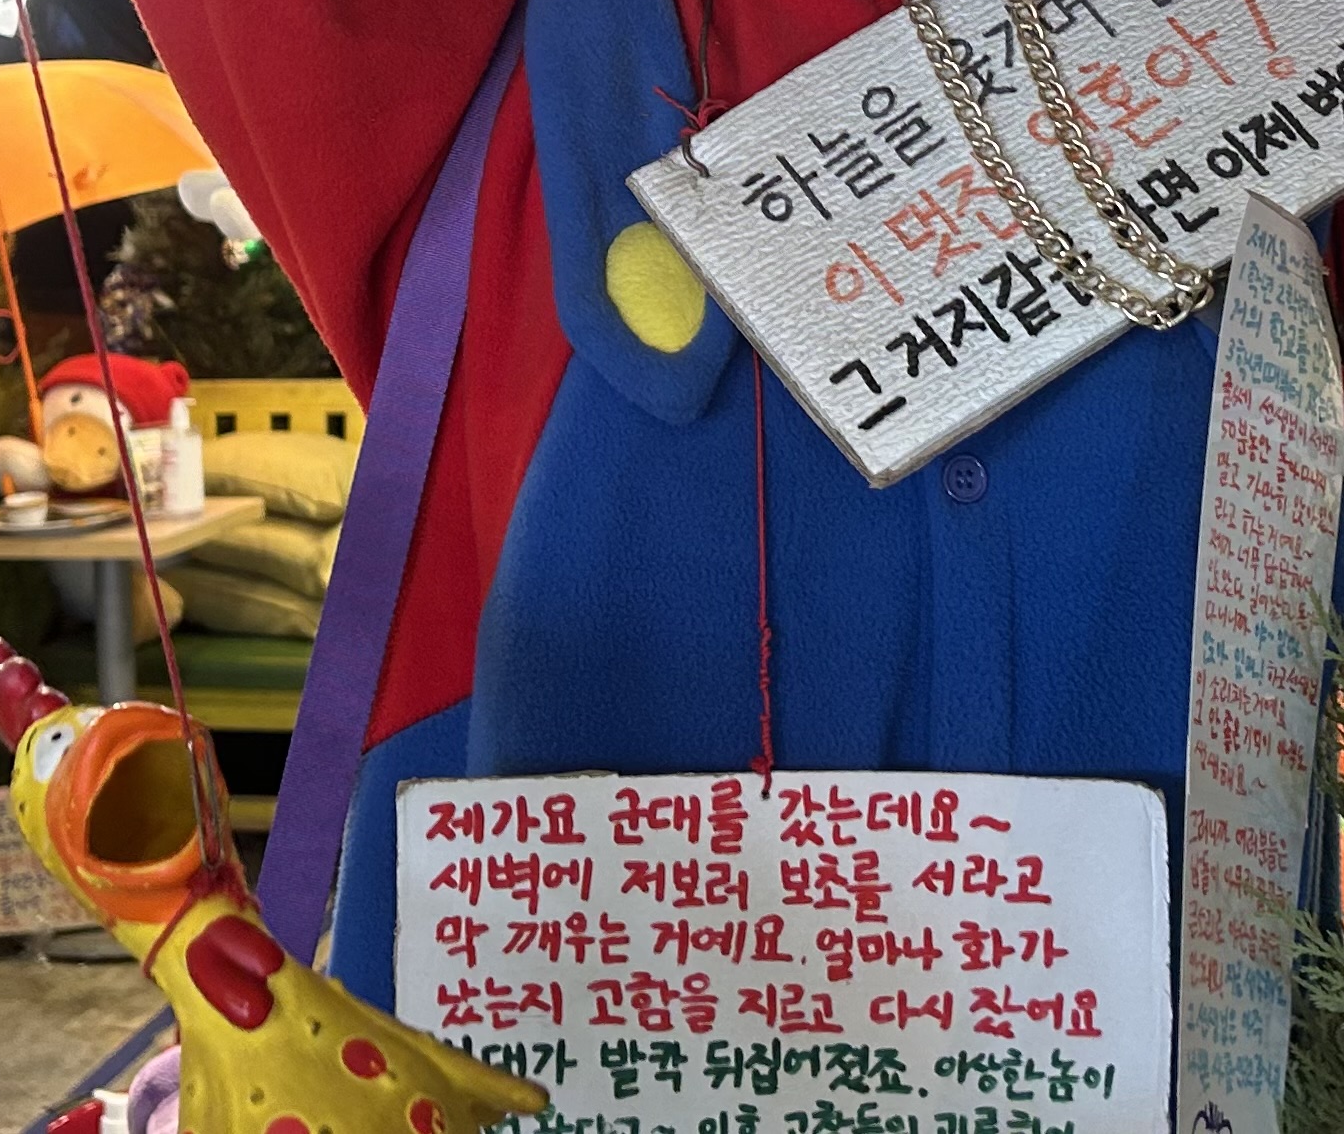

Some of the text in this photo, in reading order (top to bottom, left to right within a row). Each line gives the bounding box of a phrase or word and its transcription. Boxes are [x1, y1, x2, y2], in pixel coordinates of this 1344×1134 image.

[741, 85, 947, 223] 하늘을
[824, 240, 906, 307] 이
[828, 357, 908, 431] 그
[1205, 100, 1320, 179] 이제
[1230, 297, 1263, 339] 거의
[1269, 311, 1311, 375] 학교를
[1221, 370, 1253, 411] 글쎄
[1258, 395, 1308, 447] 선생님이
[1214, 496, 1237, 530] 라고
[1216, 450, 1241, 492] 말고
[1245, 470, 1288, 517] 가만히
[1236, 544, 1261, 582] 너무
[1195, 668, 1207, 698] 이
[1193, 698, 1204, 727] 그
[1243, 724, 1273, 759] 기억이
[425, 792, 587, 845] 제가요
[607, 778, 750, 855] 군대를
[429, 849, 1053, 924] 새벽에 저보러 보초를 서라고
[436, 914, 491, 969] 막
[502, 911, 631, 965] 깨우는
[815, 926, 944, 983] 얼마나
[437, 970, 1103, 1040] 났는지 고함을 지르고 다시 잤어요
[600, 1037, 689, 1099] 발칵
